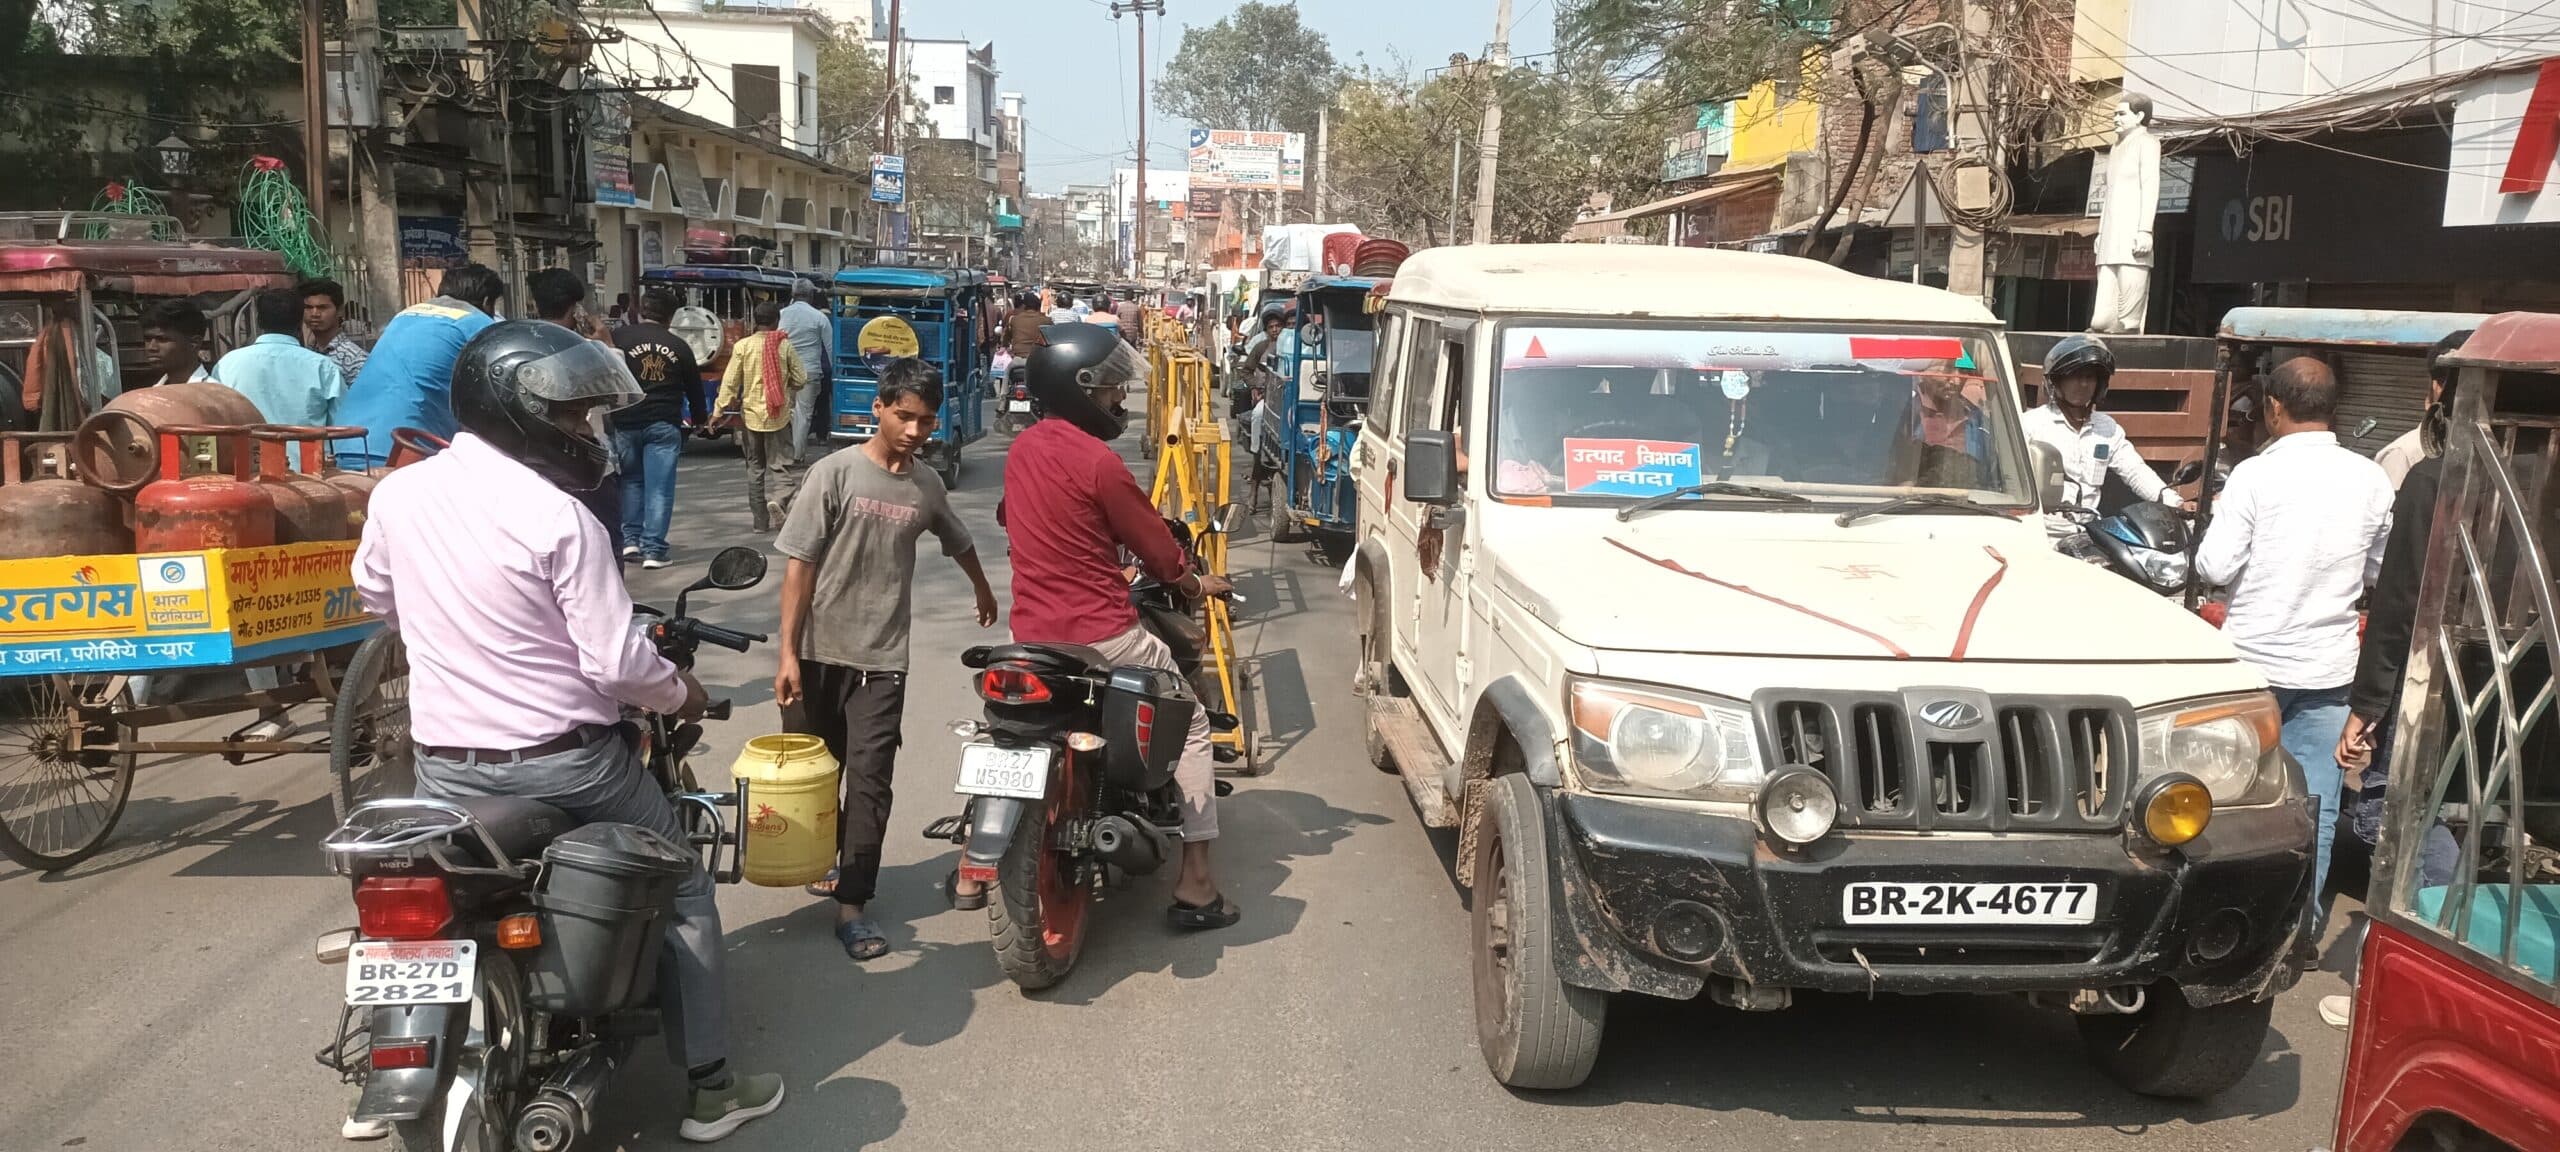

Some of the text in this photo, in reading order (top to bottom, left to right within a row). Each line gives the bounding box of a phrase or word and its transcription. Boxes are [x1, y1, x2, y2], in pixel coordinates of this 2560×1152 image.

[2248, 195, 2293, 241] SBI
[629, 343, 679, 364] NEW YORK
[1572, 445, 1692, 467] उत्पाद विभाग
[1596, 470, 1674, 486] नवादा
[231, 552, 268, 593] माधुरी
[272, 550, 291, 580] श्री
[153, 594, 188, 607] भारत
[71, 640, 137, 661] परोसिये
[1852, 886, 2088, 916] BR-2K-4677
[359, 962, 459, 981] BR-27D
[353, 982, 463, 1002] 2821
